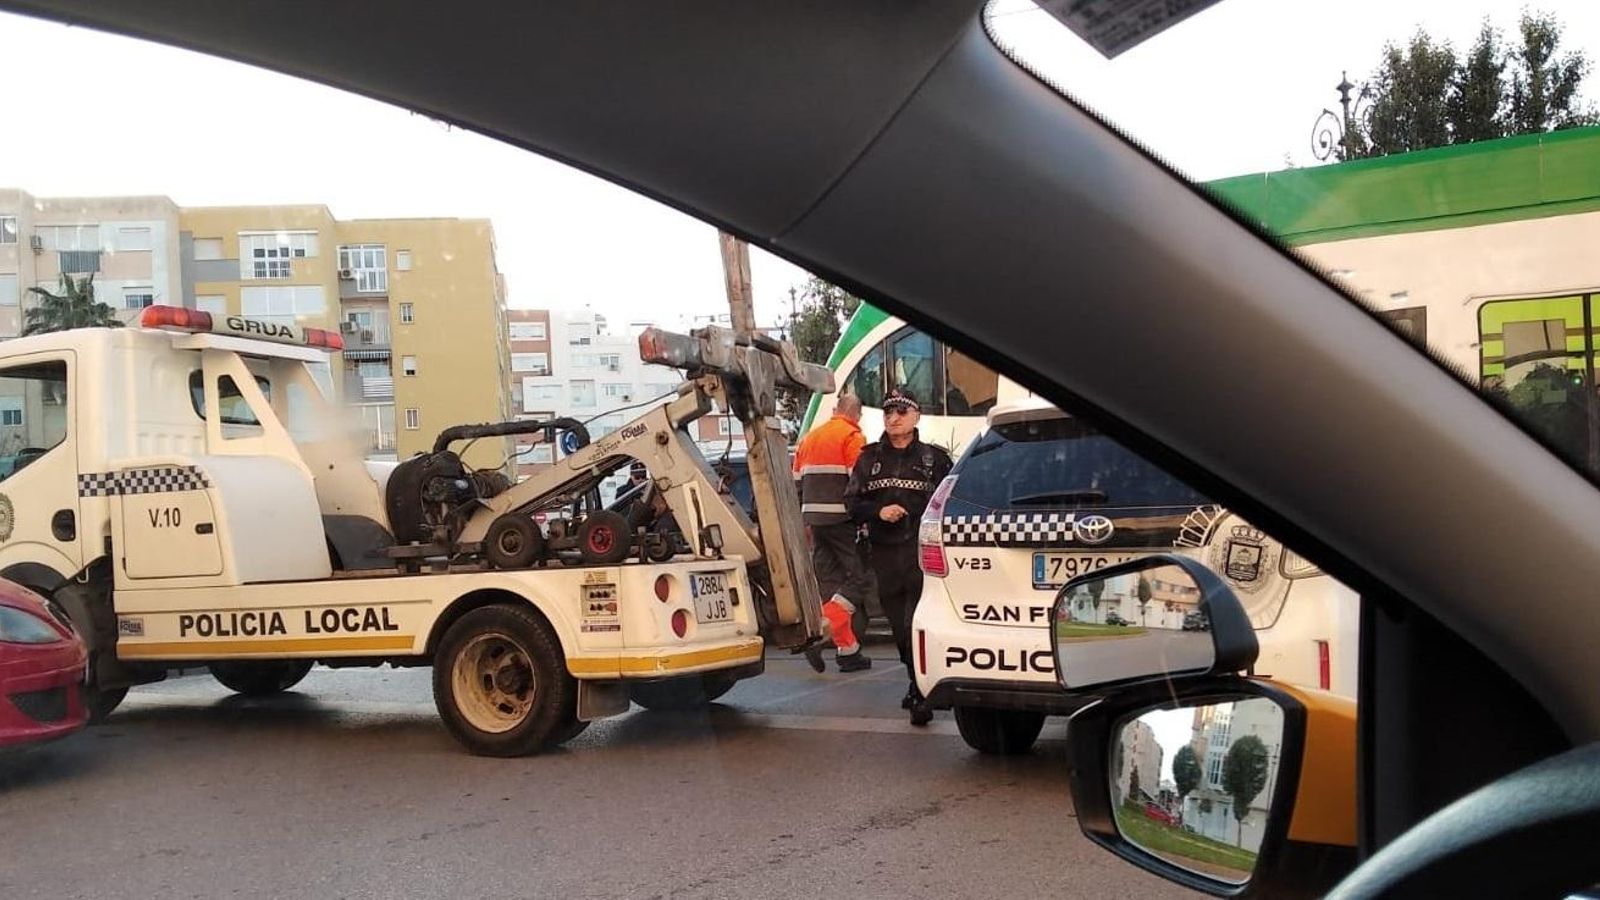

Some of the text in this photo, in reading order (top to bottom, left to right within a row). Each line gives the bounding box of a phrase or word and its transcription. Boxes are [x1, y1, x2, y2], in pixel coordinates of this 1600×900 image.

[226, 316, 294, 339] GRUA
[148, 507, 181, 528] V.10
[954, 557, 992, 570] V-23
[698, 576, 724, 595] 2884
[706, 600, 727, 619] JJB
[963, 603, 1020, 622] SAN
[179, 606, 398, 637] POLICIA LOCAL
